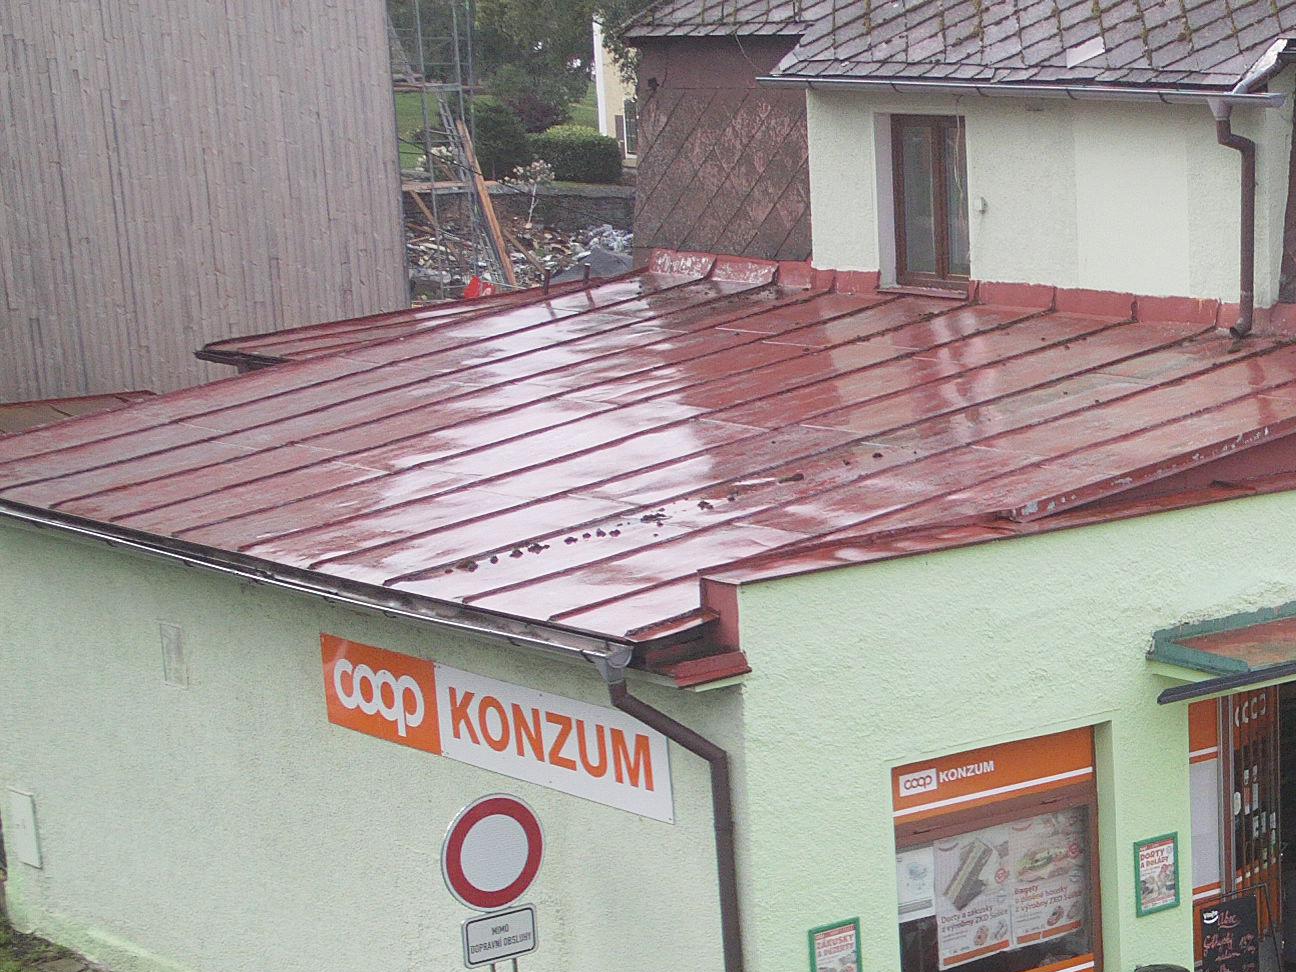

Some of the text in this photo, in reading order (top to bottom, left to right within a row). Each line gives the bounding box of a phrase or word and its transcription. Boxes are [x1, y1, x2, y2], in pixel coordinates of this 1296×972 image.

[333, 658, 655, 792] coop KONZUM
[903, 760, 995, 789] coop KONZUM
[491, 923, 509, 935] MIMO
